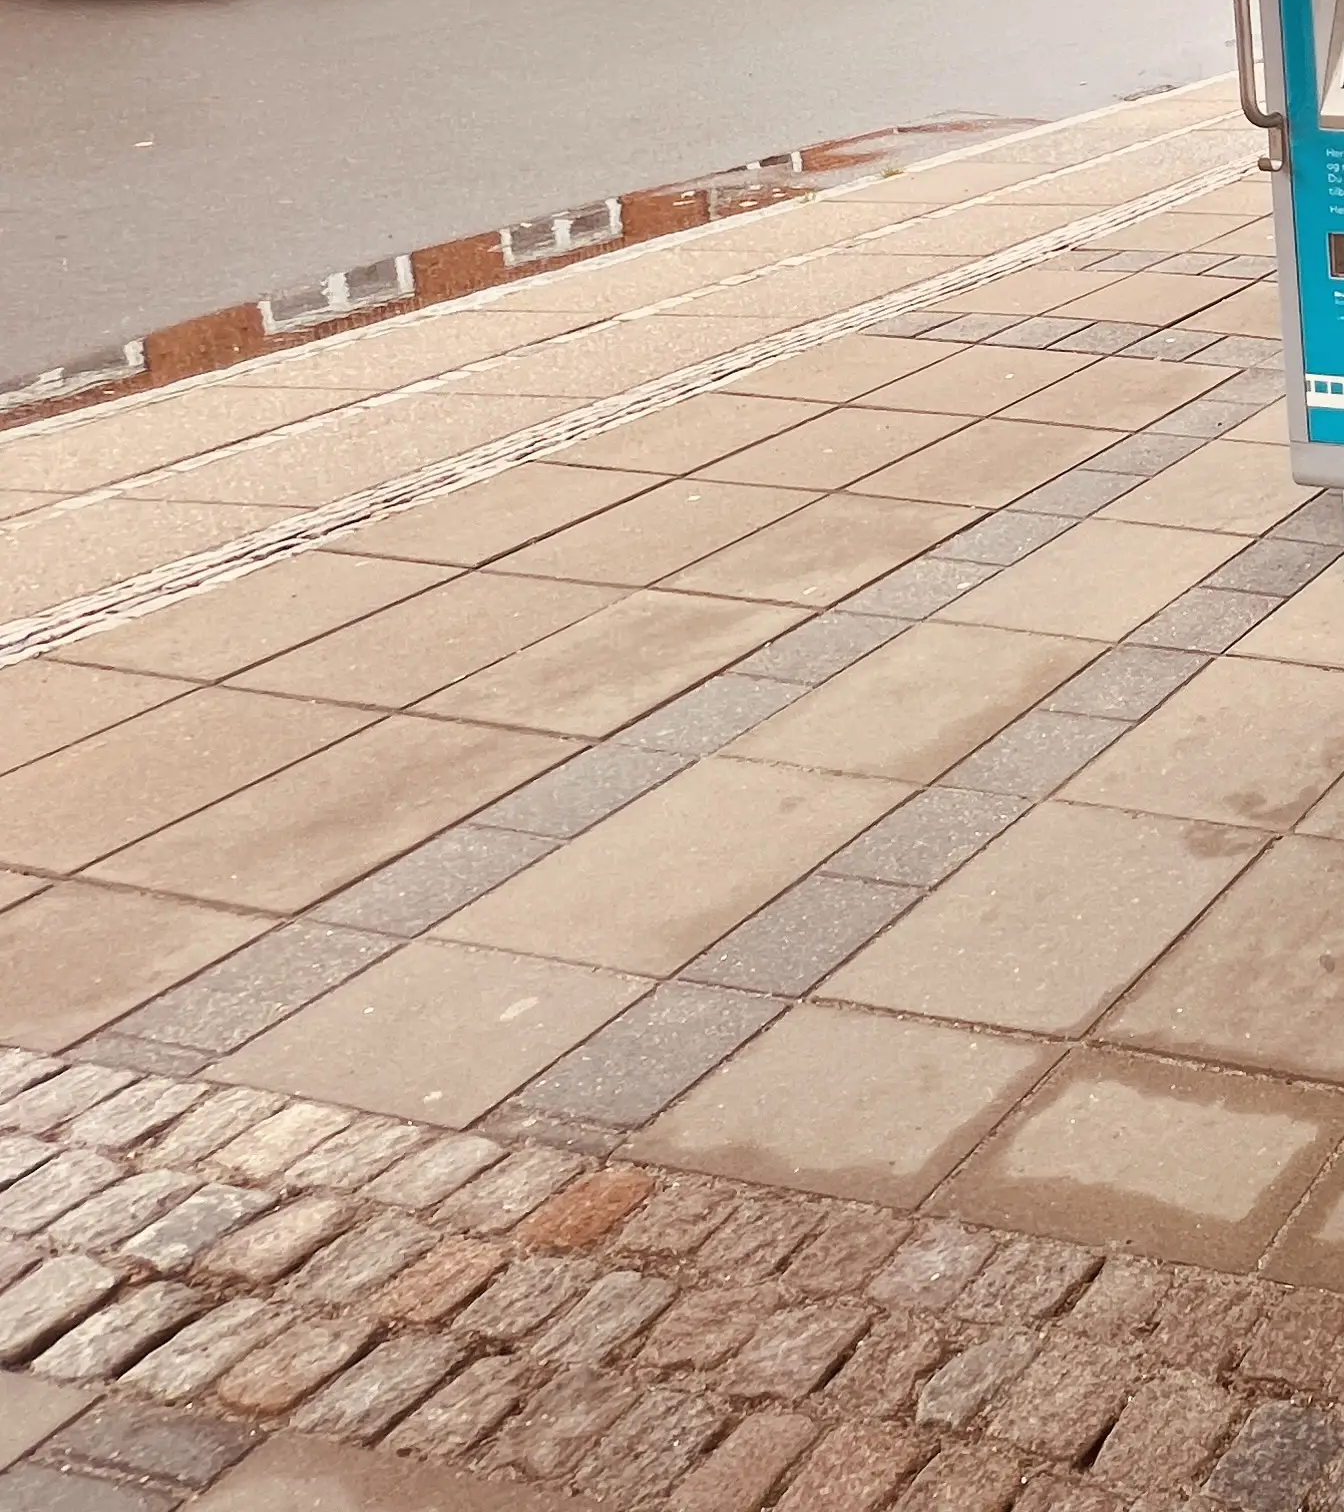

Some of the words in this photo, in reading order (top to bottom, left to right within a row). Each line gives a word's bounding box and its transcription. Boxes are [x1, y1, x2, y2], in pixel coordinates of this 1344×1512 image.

[1326, 149, 1344, 158] Her
[1326, 164, 1339, 172] og
[1328, 174, 1342, 183] Du
